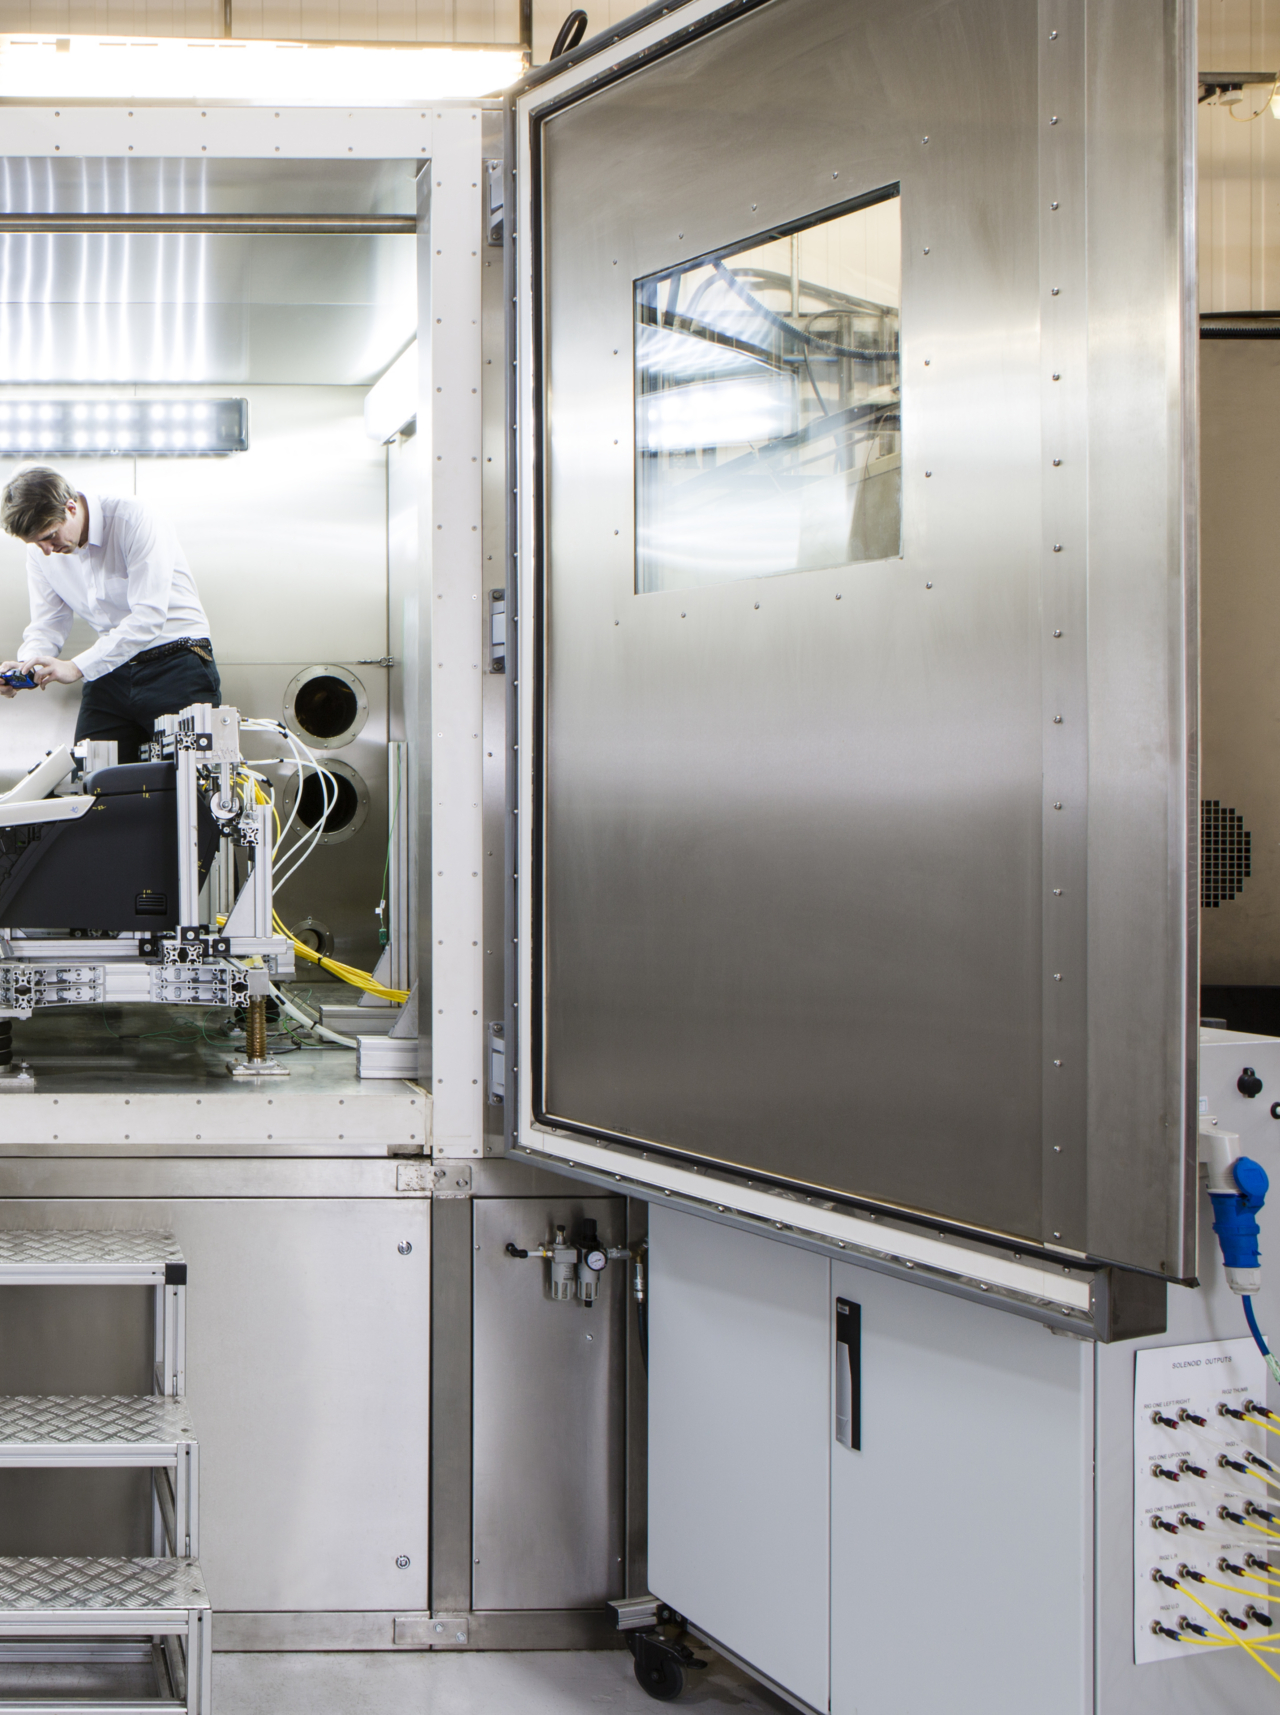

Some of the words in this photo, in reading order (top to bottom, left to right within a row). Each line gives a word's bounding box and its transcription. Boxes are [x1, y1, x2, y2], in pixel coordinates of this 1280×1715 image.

[1172, 1360, 1202, 1370] SOLENOID
[1204, 1356, 1232, 1365] OUTPUTS
[1164, 1502, 1196, 1510] THUMBWHEEL
